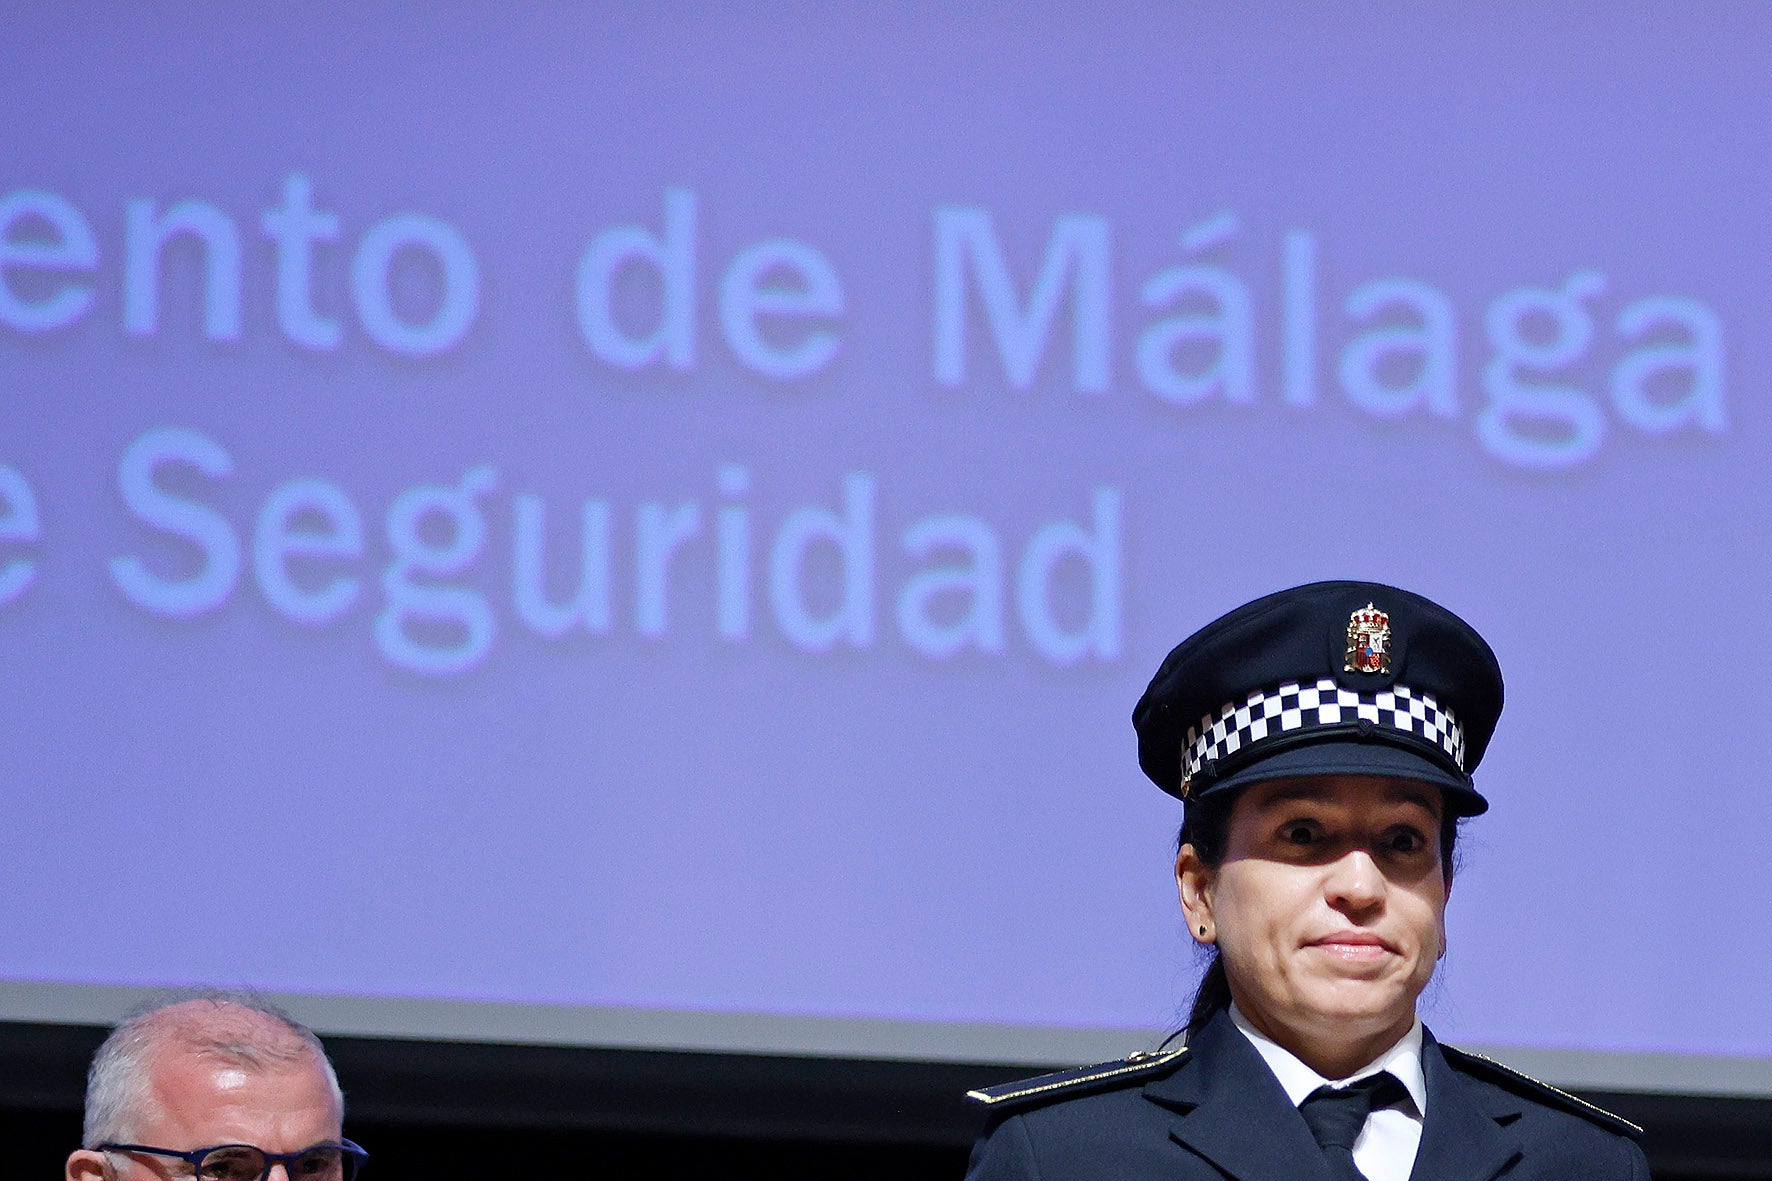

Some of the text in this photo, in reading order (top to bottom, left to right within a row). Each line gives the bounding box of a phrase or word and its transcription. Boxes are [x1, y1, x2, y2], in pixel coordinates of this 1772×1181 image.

[574, 188, 845, 378] de
[928, 203, 1730, 468] Málaga
[108, 425, 1127, 674] Seguridad
